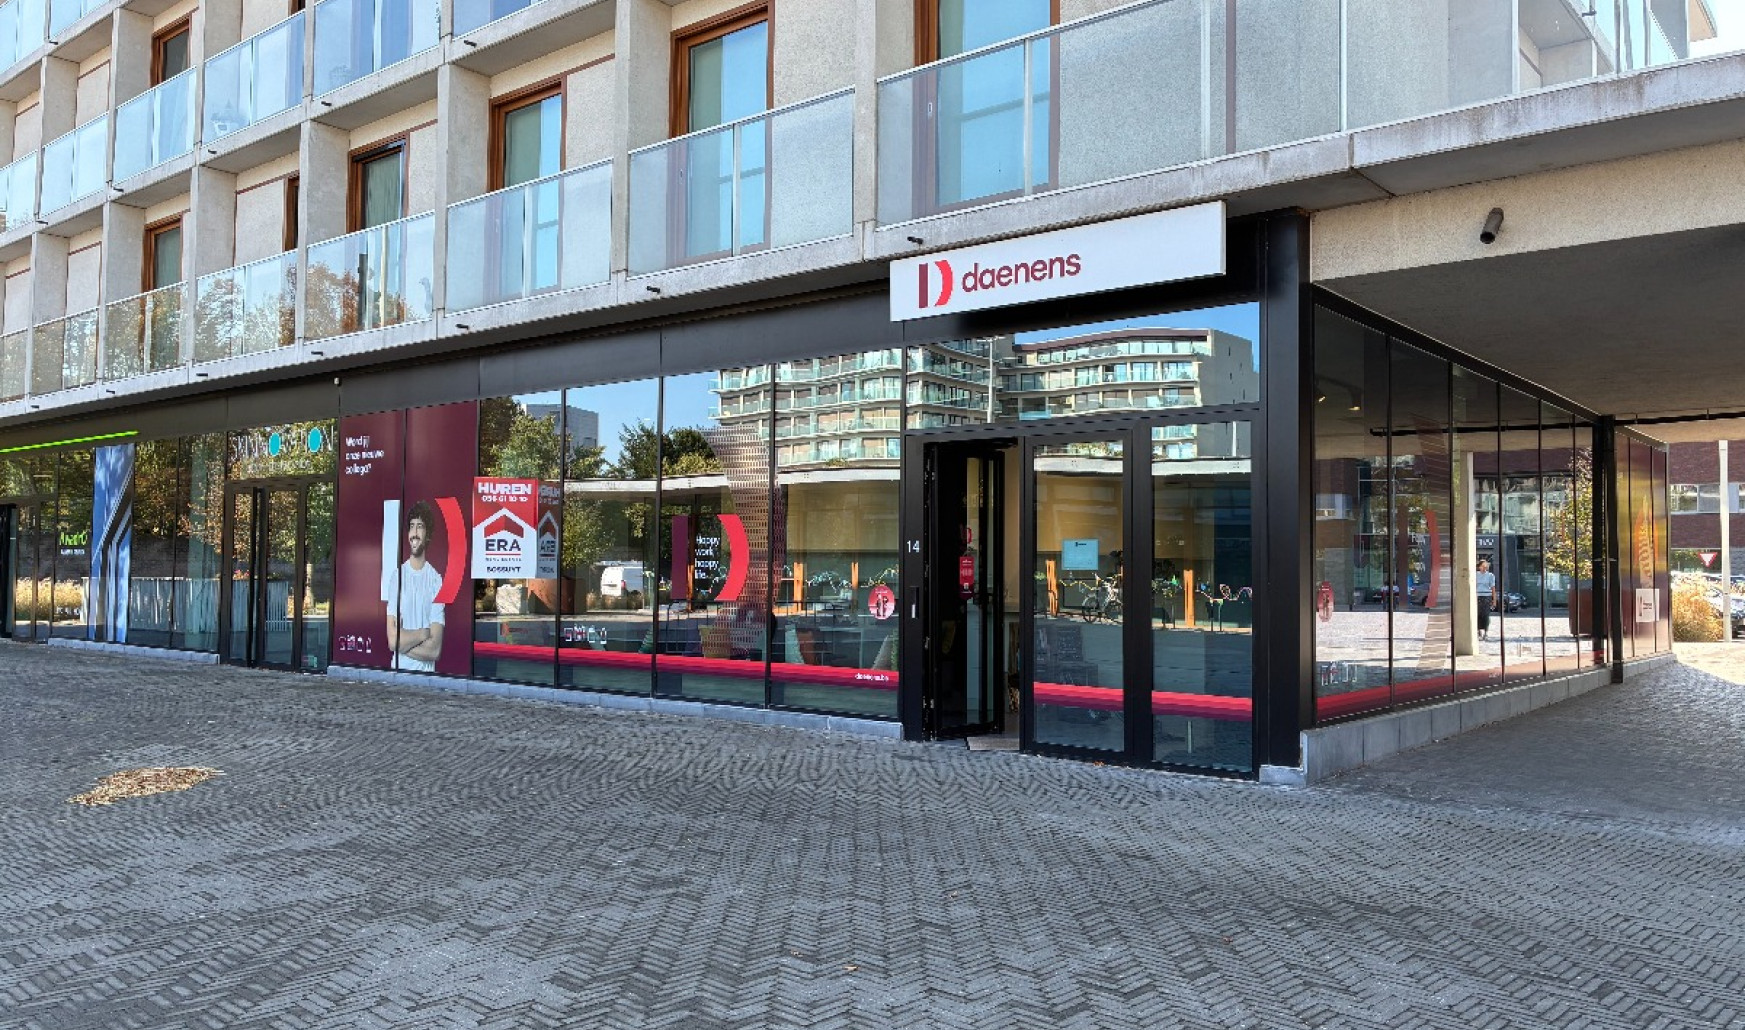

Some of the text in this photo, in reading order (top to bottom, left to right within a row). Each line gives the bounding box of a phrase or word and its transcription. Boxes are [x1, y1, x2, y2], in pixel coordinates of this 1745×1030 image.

[962, 253, 1081, 293] daenens
[477, 482, 532, 495] HUREN
[485, 539, 521, 552] ERA
[906, 540, 920, 553] 14
[695, 558, 719, 570] happy
